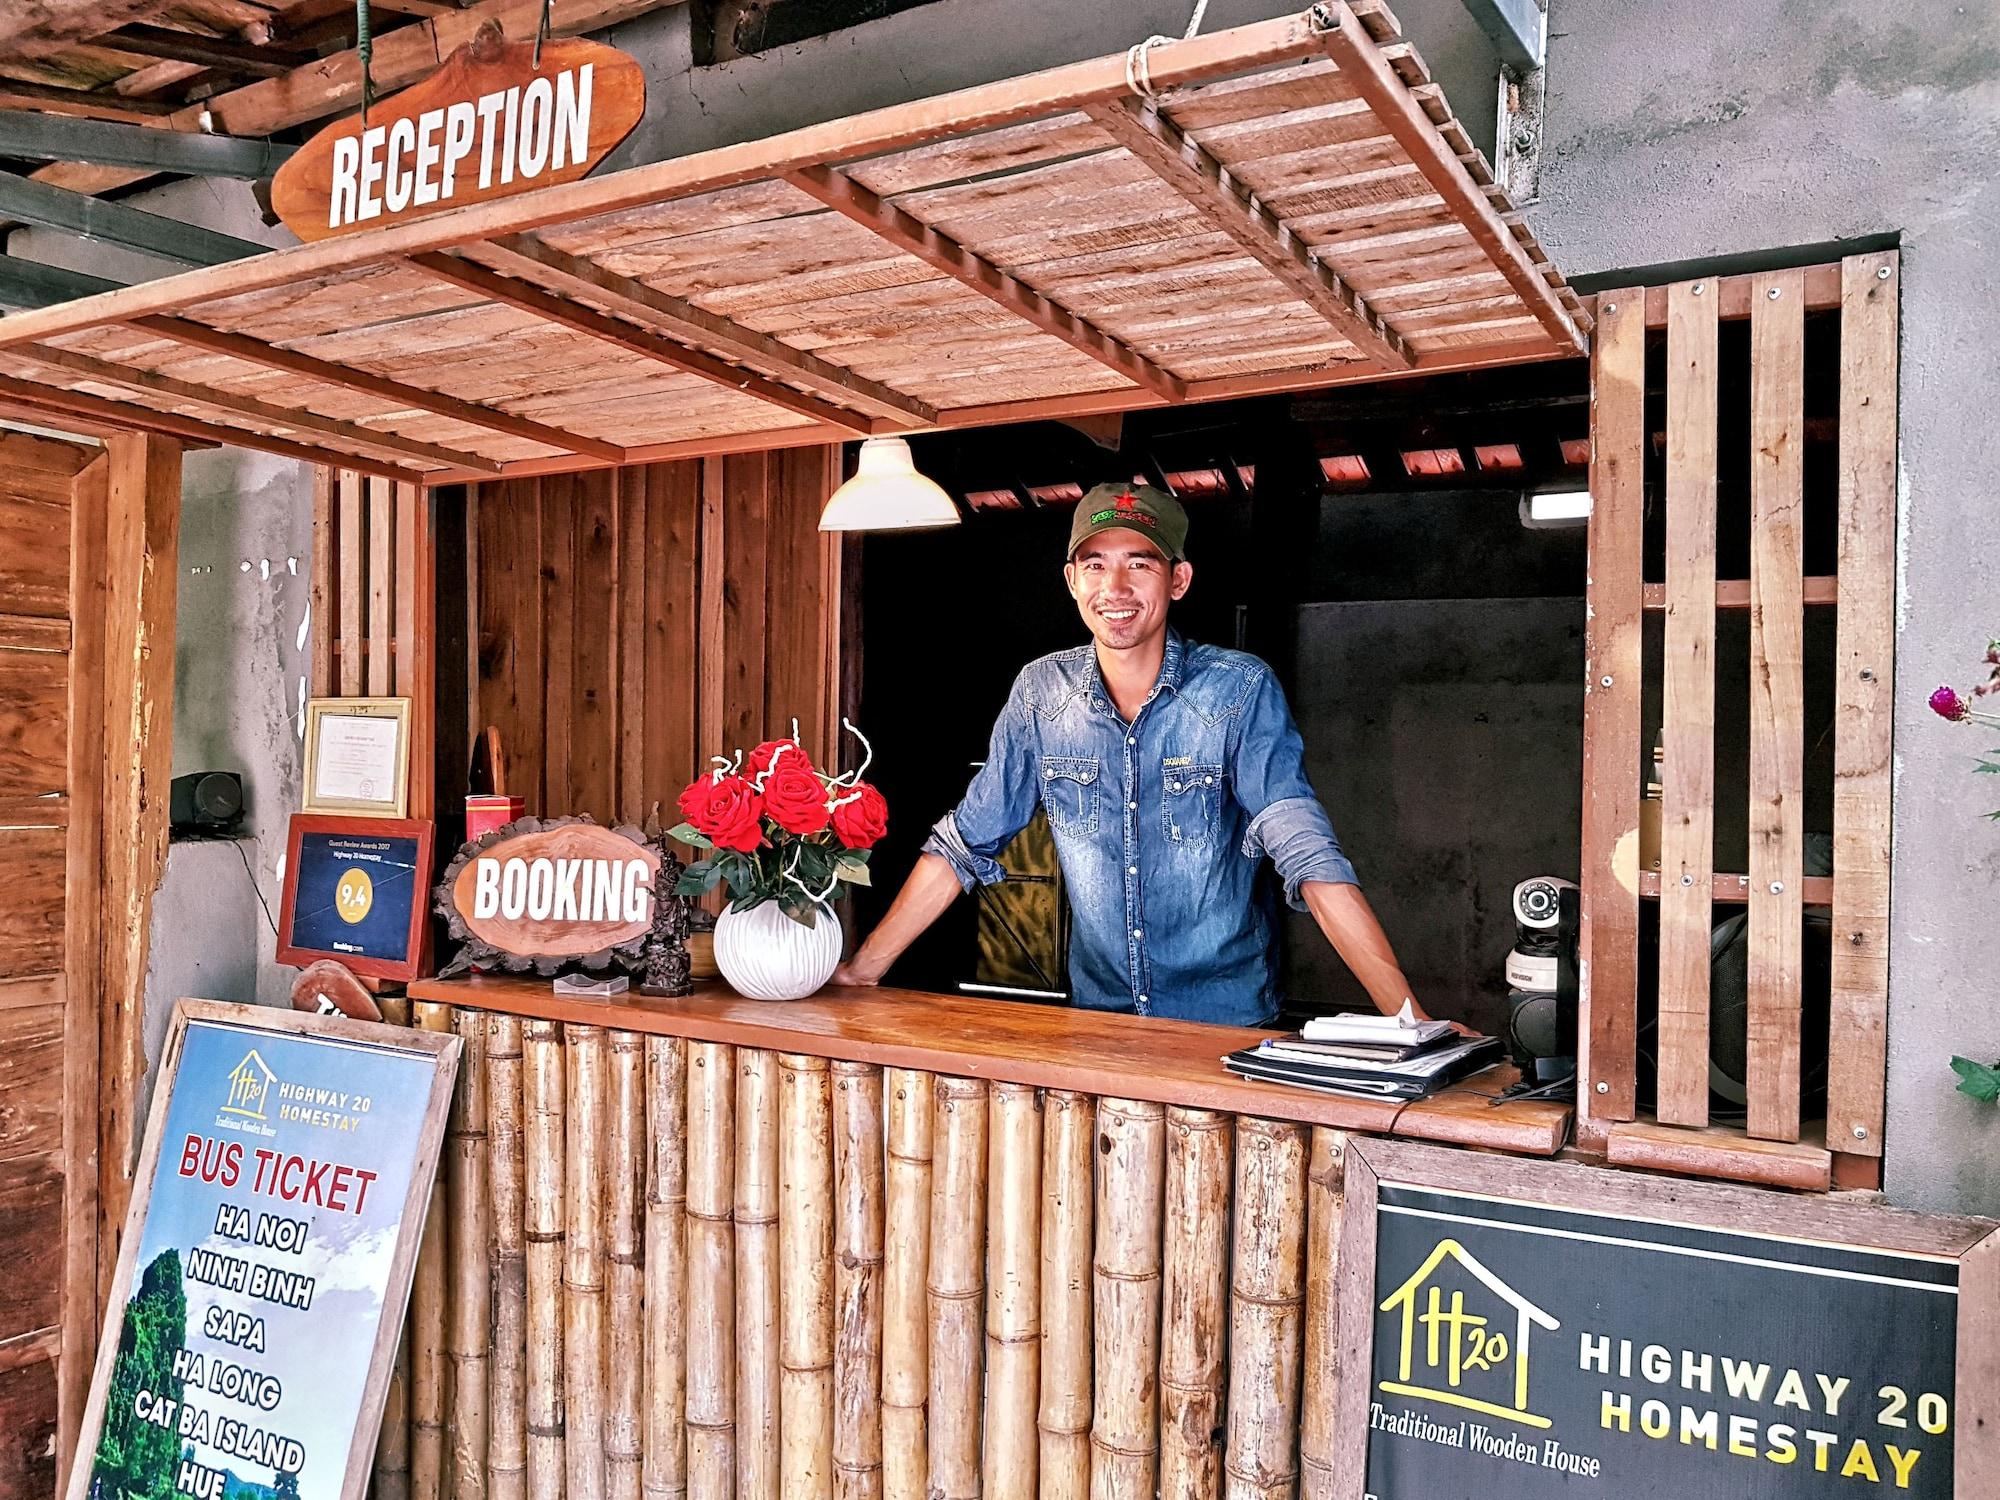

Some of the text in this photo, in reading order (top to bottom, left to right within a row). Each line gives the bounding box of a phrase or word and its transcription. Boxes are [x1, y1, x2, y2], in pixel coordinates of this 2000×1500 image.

[329, 63, 594, 229] RECEPTION
[328, 839, 343, 848] Guest
[360, 841, 378, 850] Awards
[378, 842, 391, 851] 2017
[333, 850, 353, 860] Highway
[341, 884, 367, 907] 9,4
[474, 857, 649, 922] BOOKING
[278, 1082, 372, 1113] HIGHWAY 20
[279, 1103, 360, 1132] HOMESTAY
[178, 1134, 377, 1215] BUS TICKET
[215, 1204, 308, 1254] HA NOI
[187, 1248, 316, 1310] NINH BINH
[204, 1305, 265, 1353] SAPA
[171, 1348, 282, 1411] HA LONG
[1579, 1332, 1949, 1435] HIGHWAY 20
[134, 1389, 305, 1475] CAT BA ISLAND
[1370, 1402, 1600, 1478] Traditional Wooden House
[1600, 1390, 1921, 1489] HOMESTAY
[176, 1460, 226, 1500] HUE
